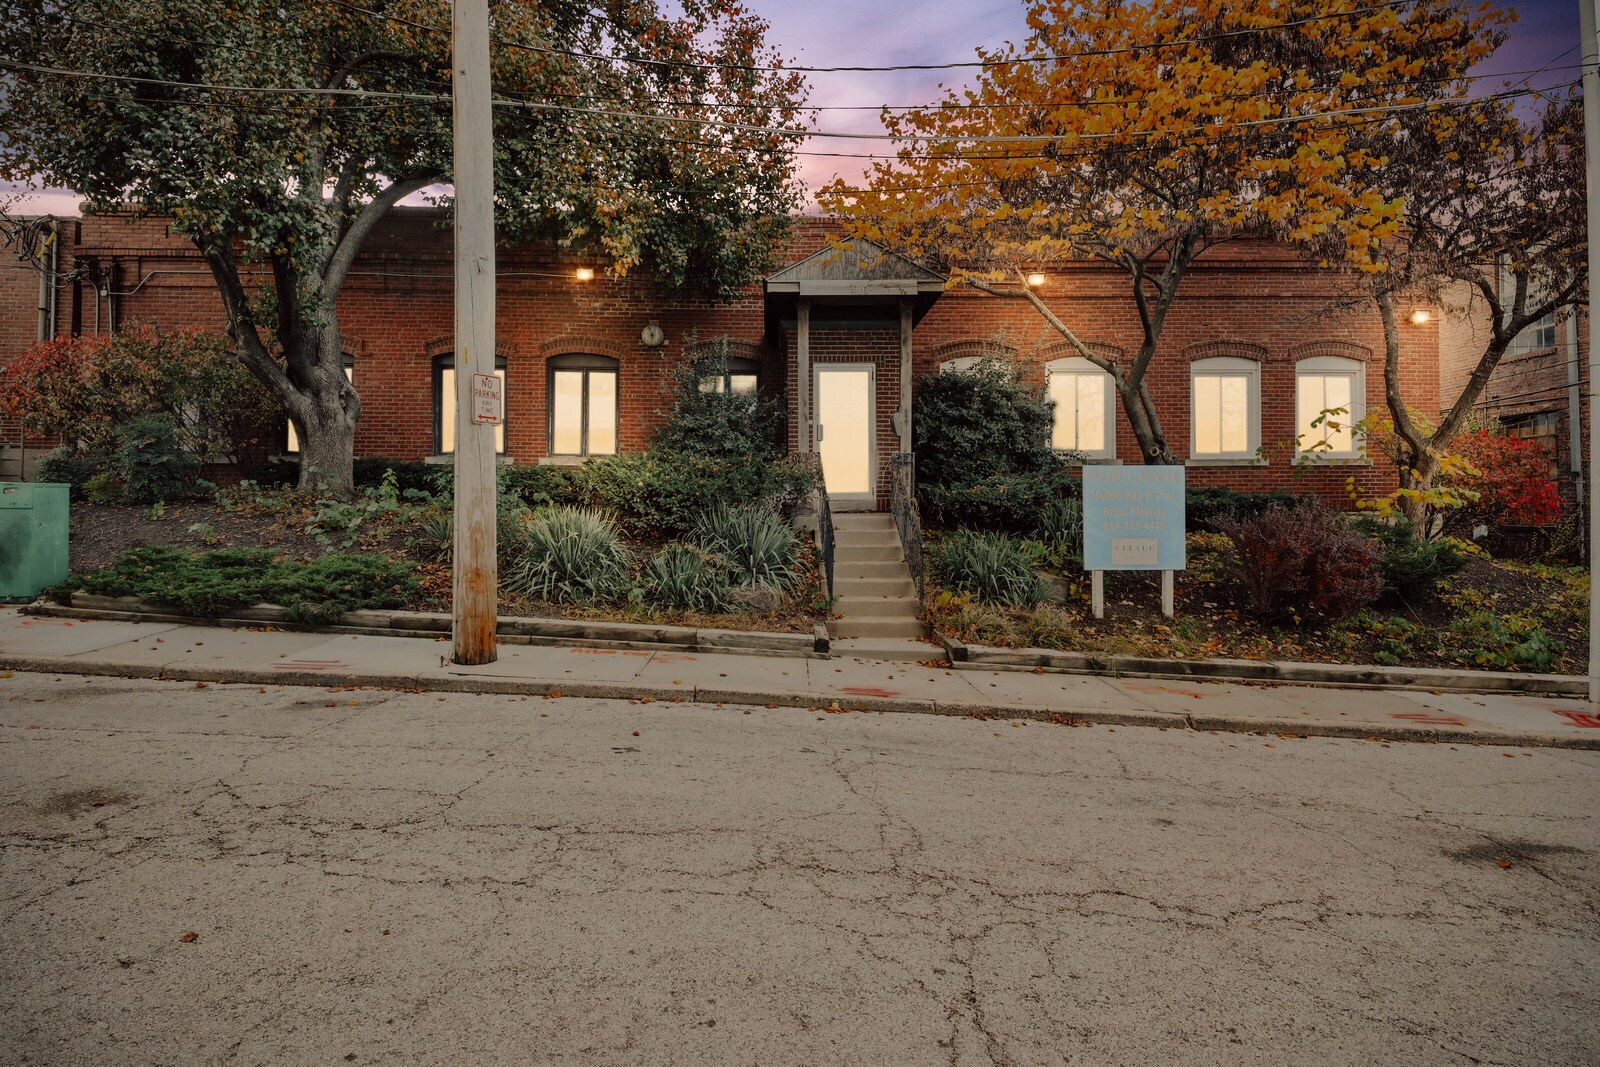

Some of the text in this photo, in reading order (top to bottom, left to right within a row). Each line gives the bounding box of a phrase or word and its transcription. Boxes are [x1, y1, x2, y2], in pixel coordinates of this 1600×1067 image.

[481, 379, 493, 389] NO
[474, 389, 499, 400] PARKING
[1089, 469, 1180, 482] FOR LEASE
[1103, 505, 1168, 519] Brian Fleming
